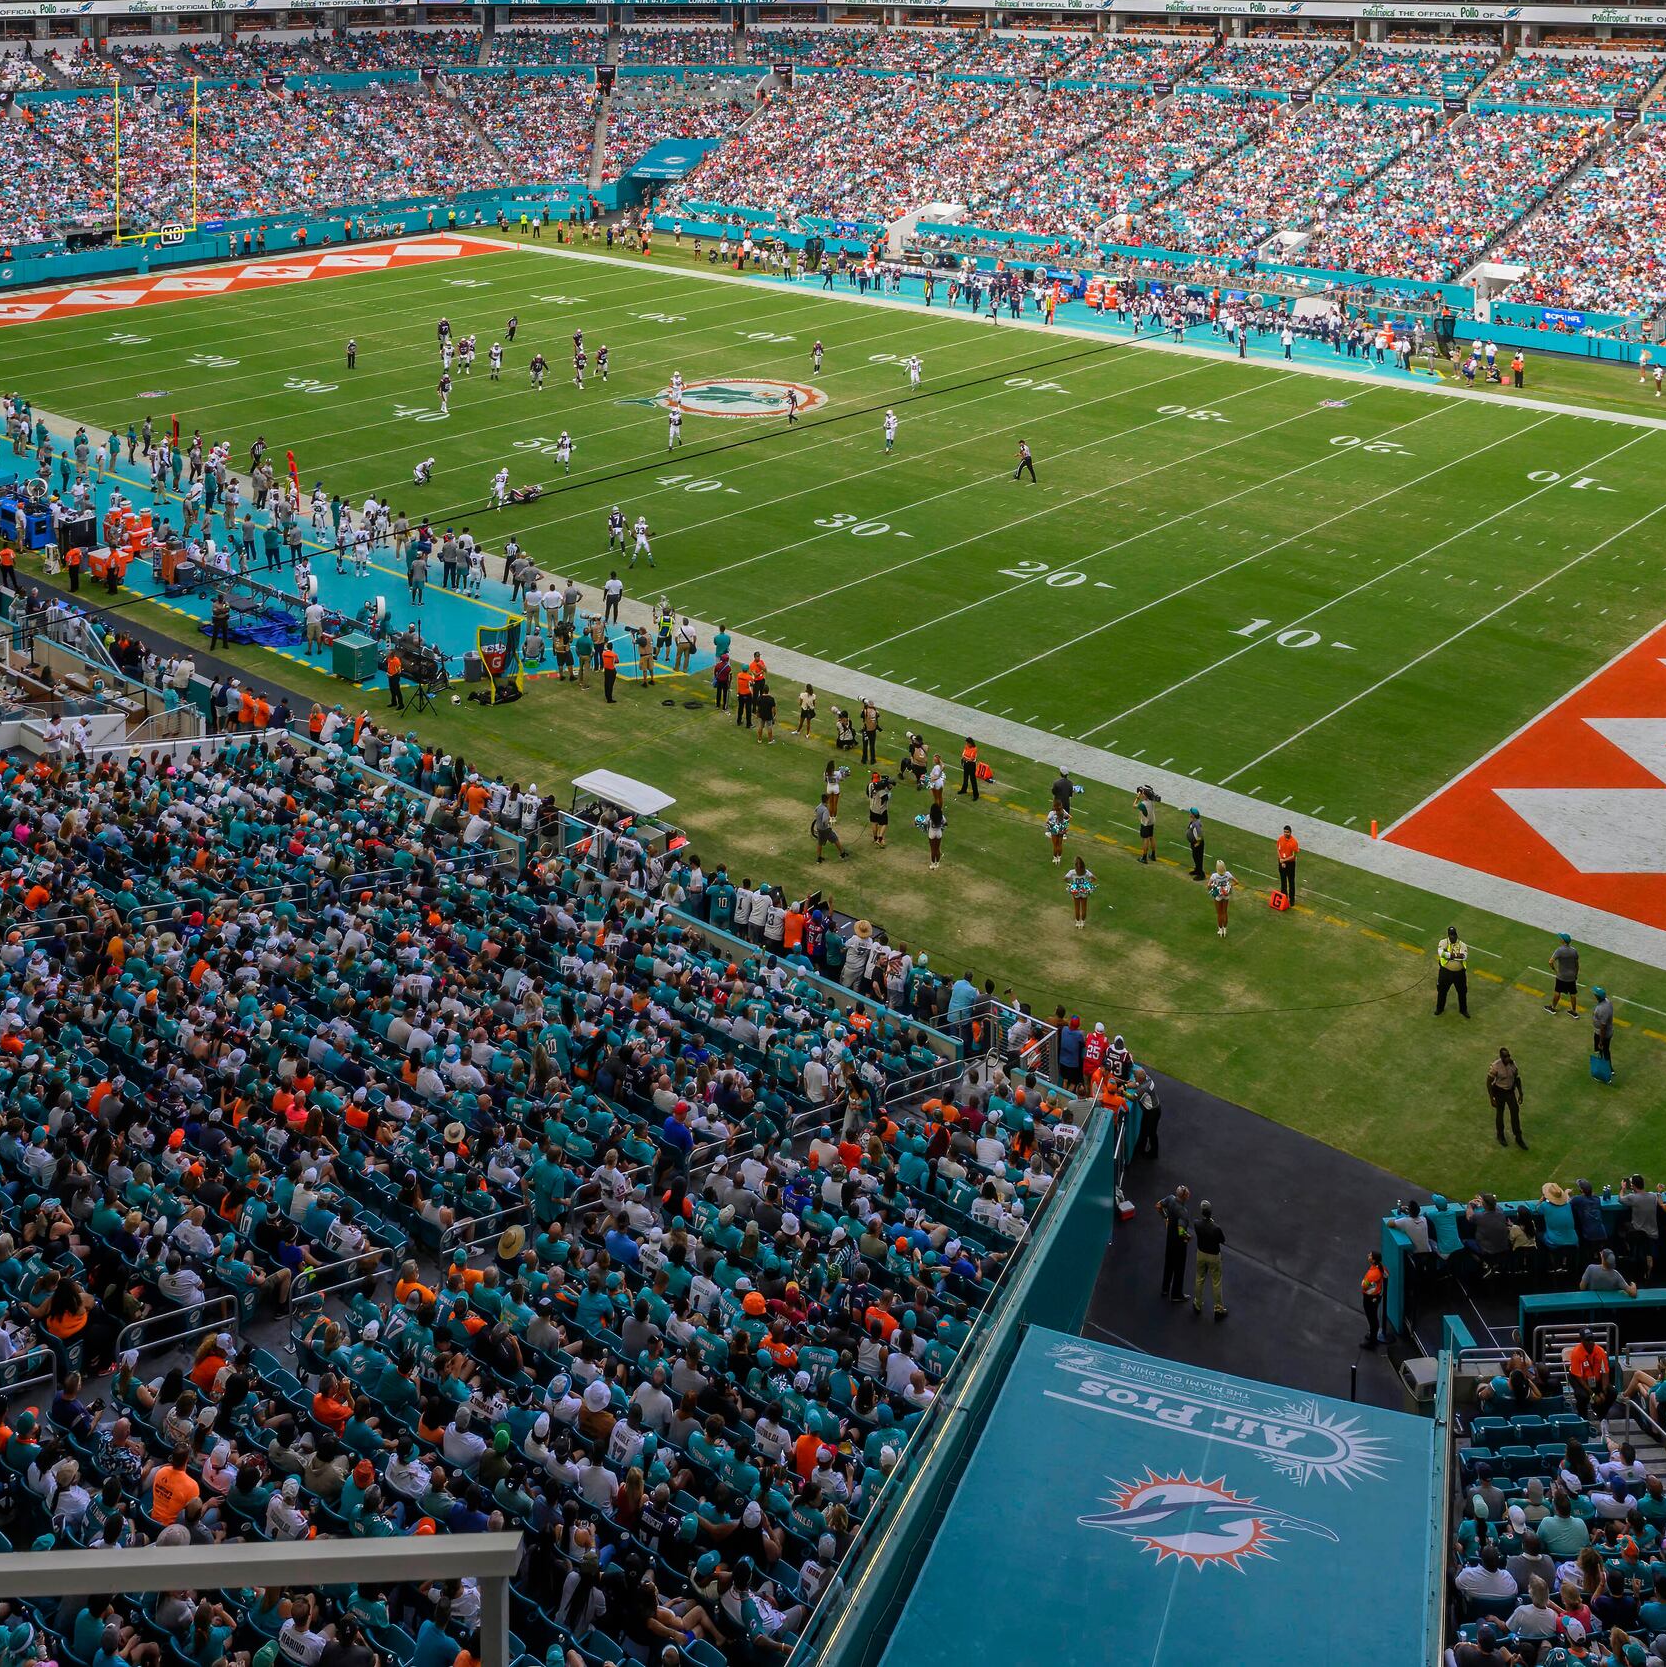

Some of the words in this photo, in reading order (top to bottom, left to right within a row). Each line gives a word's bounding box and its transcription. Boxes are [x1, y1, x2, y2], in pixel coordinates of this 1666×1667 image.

[814, 513, 891, 536] 30
[997, 561, 1087, 587] 20
[1227, 617, 1321, 648] 10
[1077, 1379, 1204, 1427] Pros
[1210, 1414, 1308, 1449] Air
